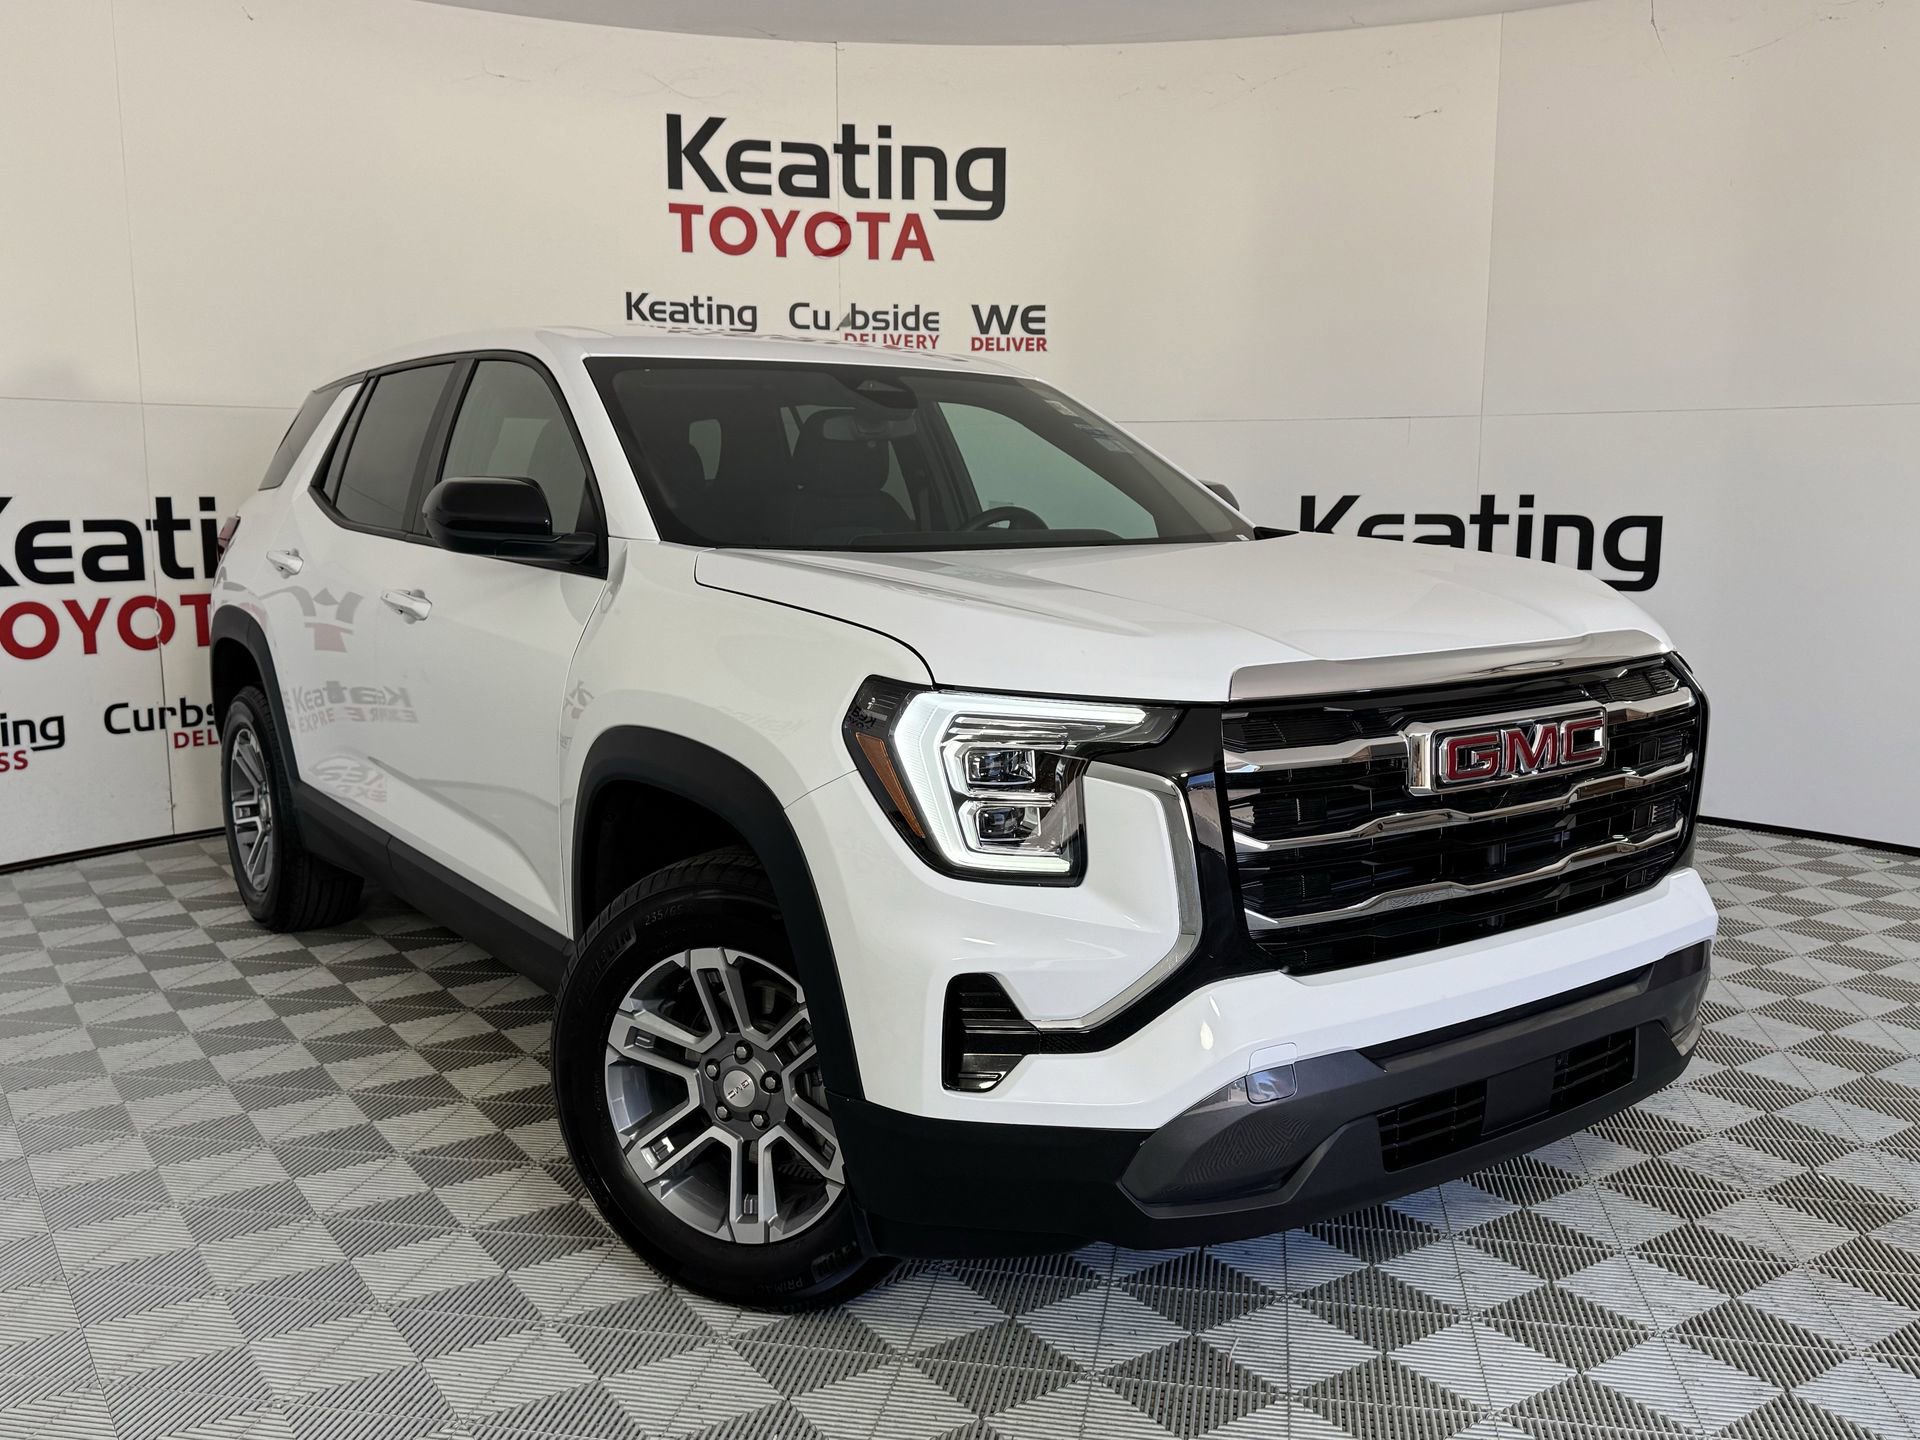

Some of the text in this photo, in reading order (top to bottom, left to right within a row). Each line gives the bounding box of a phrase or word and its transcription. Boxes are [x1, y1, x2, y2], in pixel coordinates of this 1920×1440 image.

[666, 113, 1006, 220] Keating
[668, 203, 935, 262] TOYOTA
[625, 291, 757, 332] Keating
[788, 302, 940, 332] Cubside
[971, 304, 1046, 336] WE
[970, 336, 1048, 352] DELIVER
[0, 496, 218, 587] eati
[1443, 717, 1605, 782] GMC
